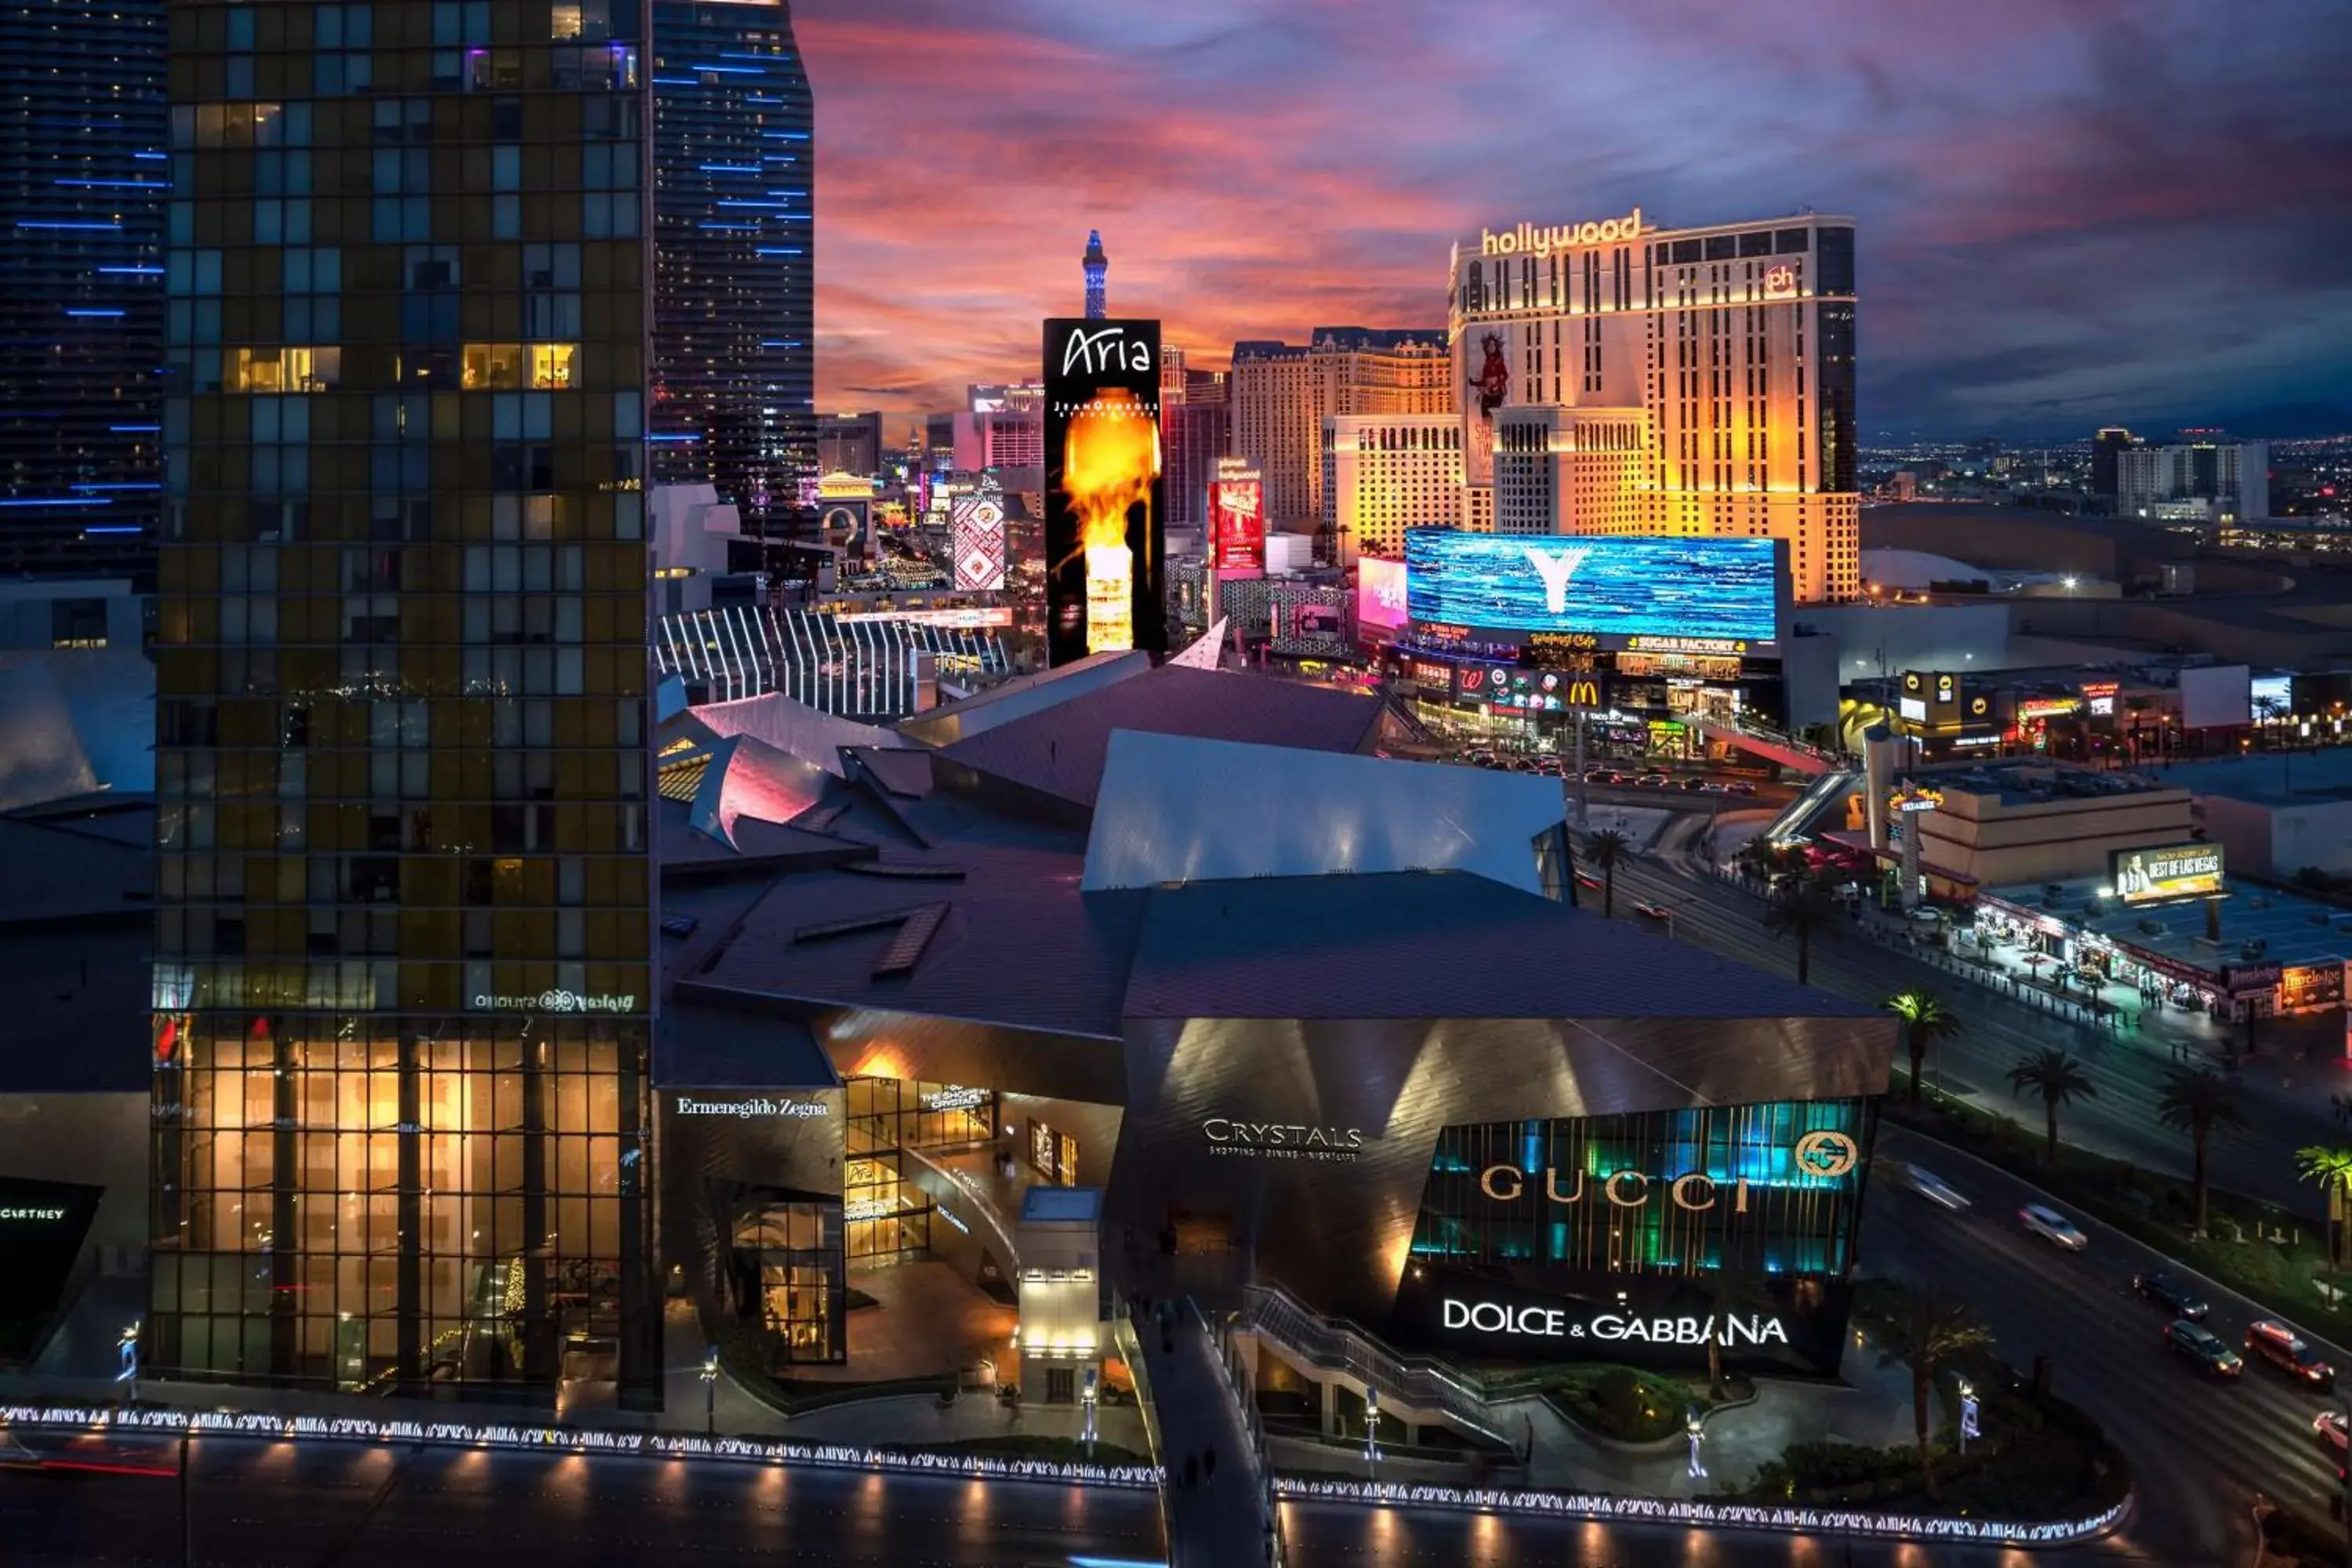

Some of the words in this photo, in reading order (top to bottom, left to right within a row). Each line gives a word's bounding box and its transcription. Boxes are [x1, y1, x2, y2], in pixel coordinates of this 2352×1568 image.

[1483, 207, 1641, 258] hollywood
[1062, 328, 1150, 376] Aria
[1639, 636, 1679, 649] SUGAR
[1681, 639, 1735, 652] FACTORY
[2284, 968, 2340, 988] Travelodge
[677, 1098, 776, 1119] Ermenegildo
[779, 1098, 828, 1119] Zegna
[1203, 1119, 1362, 1149] CRYSTALS
[1209, 1145, 1255, 1158] SHOPPING
[1266, 1147, 1298, 1160] DINING
[1482, 1165, 1748, 1213] GUCCI
[1443, 1298, 1565, 1335] DOLCE
[1570, 1323, 1584, 1338] &
[1591, 1312, 1788, 1346] GABBANA
